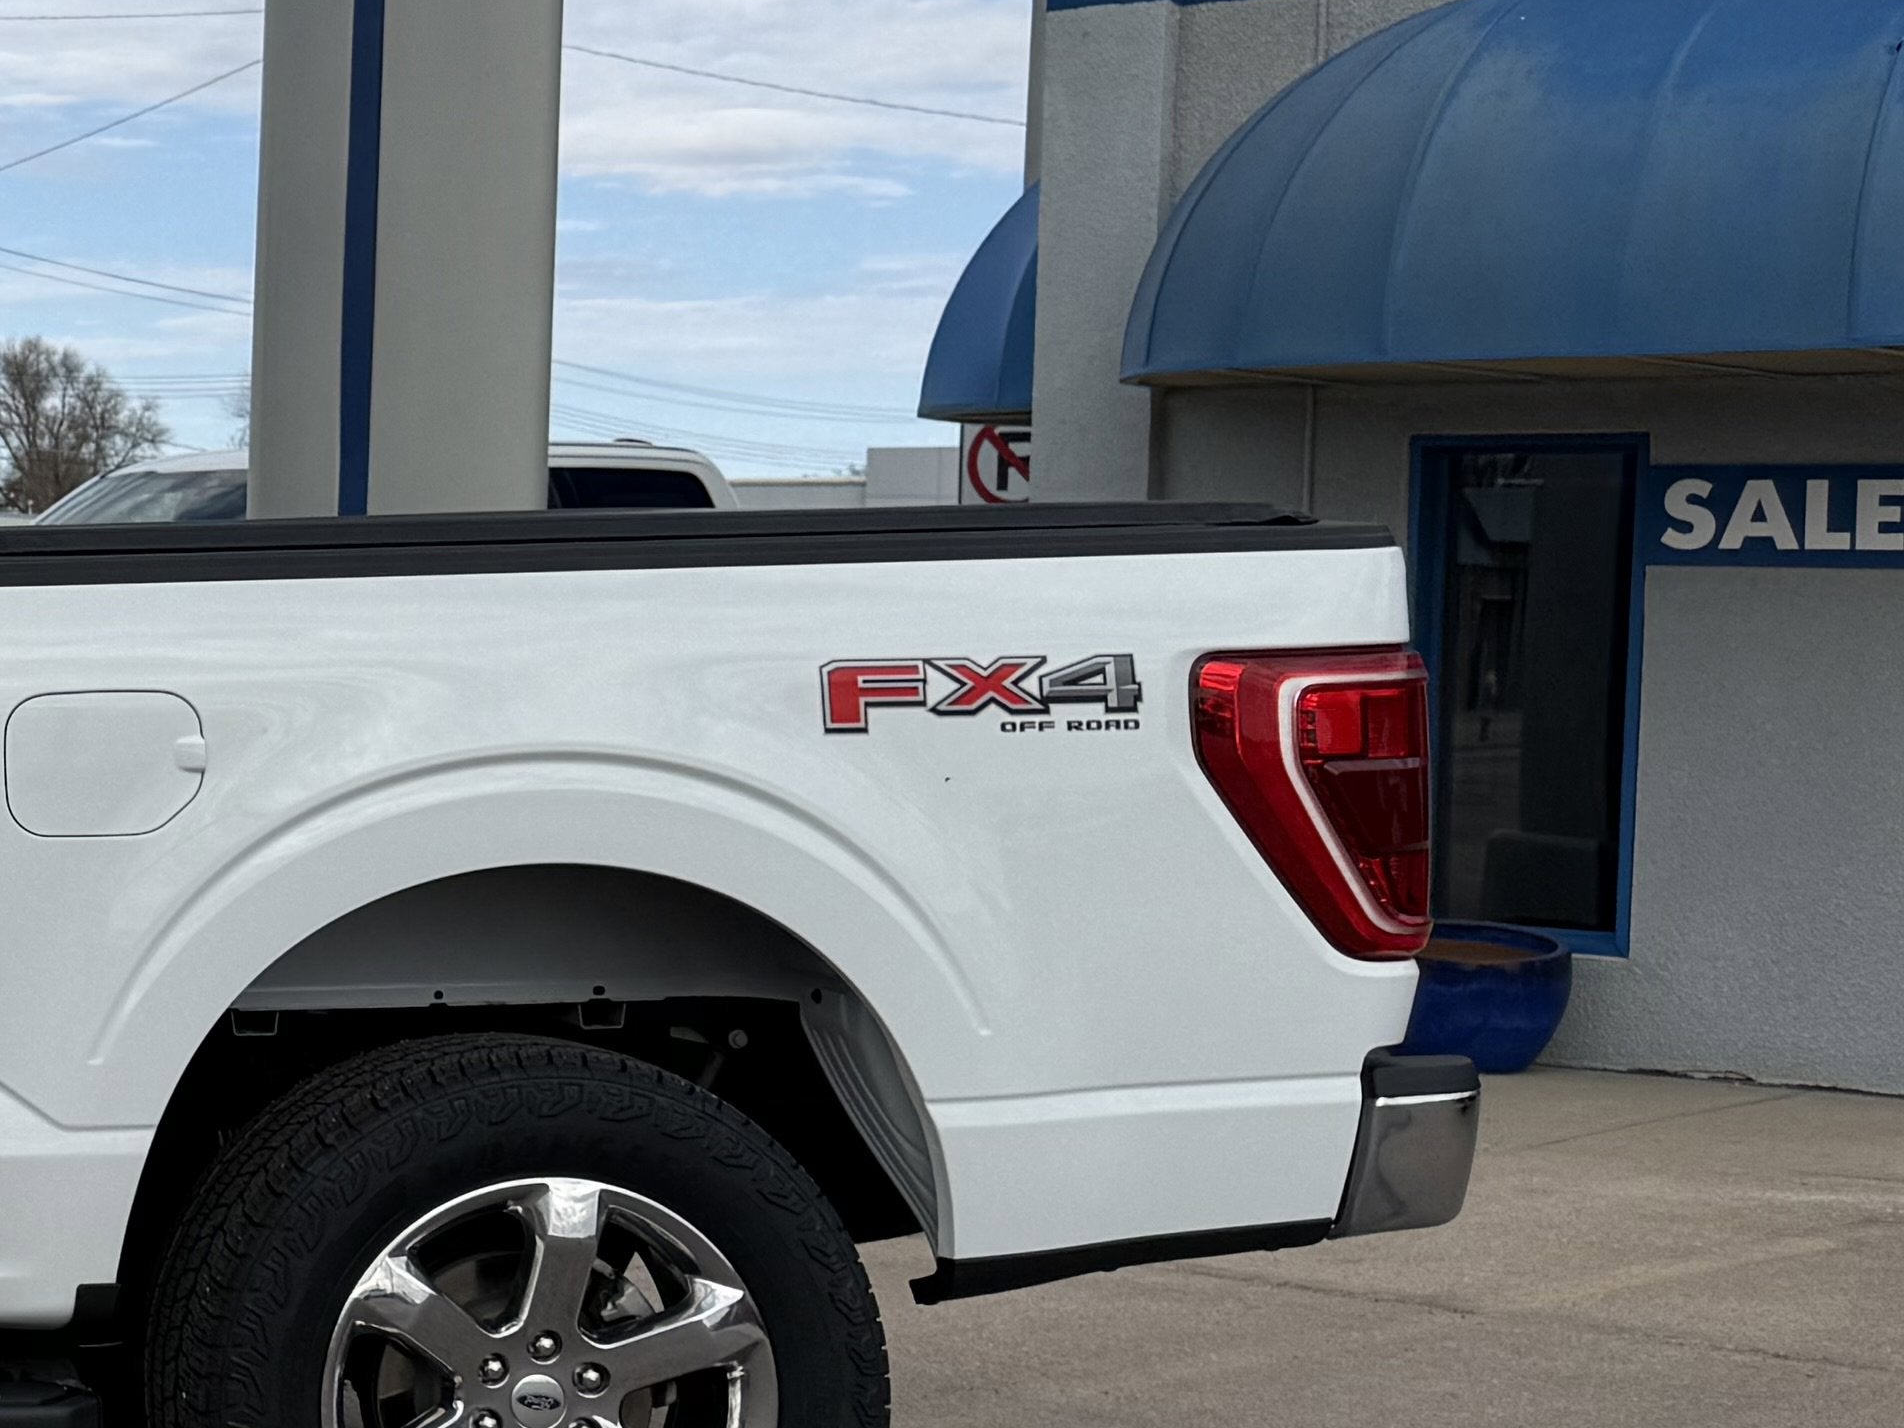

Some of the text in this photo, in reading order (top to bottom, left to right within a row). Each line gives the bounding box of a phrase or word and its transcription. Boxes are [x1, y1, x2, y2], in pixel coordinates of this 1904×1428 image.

[1660, 478, 1904, 551] SALE
[820, 654, 1142, 735] FX4
[1000, 718, 1140, 733] OFF ROAD
